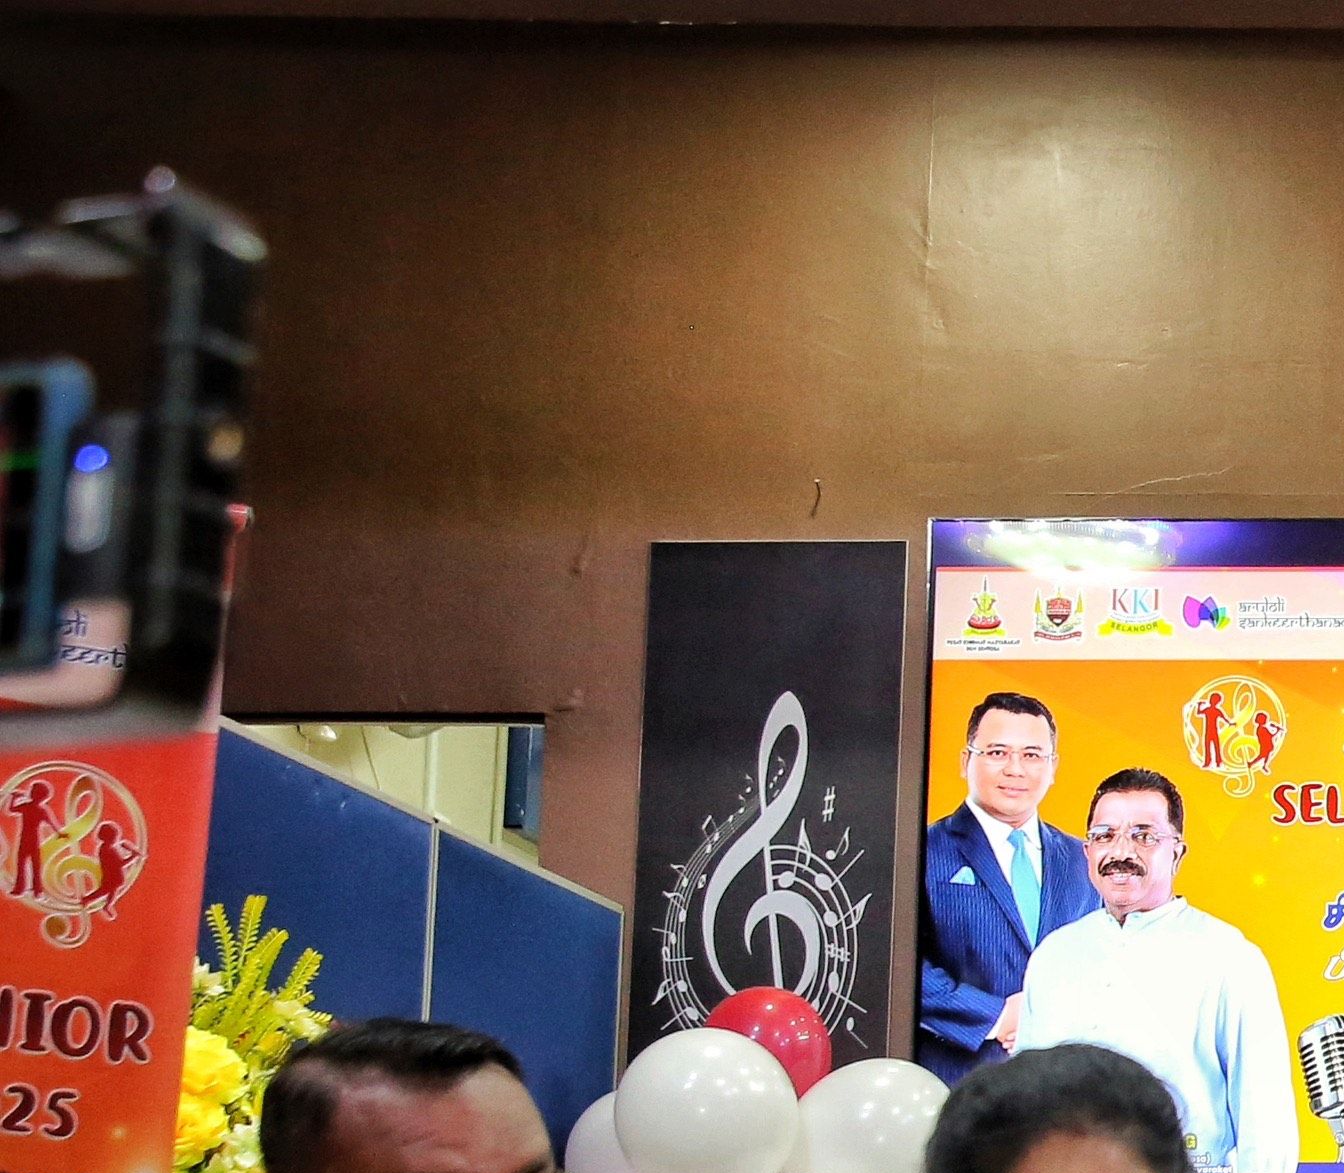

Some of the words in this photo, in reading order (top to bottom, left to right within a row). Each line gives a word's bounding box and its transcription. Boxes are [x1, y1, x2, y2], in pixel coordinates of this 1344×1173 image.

[1112, 588, 1159, 614] KKI
[1110, 621, 1159, 632] SELANGOR
[0, 985, 155, 1065] IOR
[0, 1083, 81, 1140] 25
